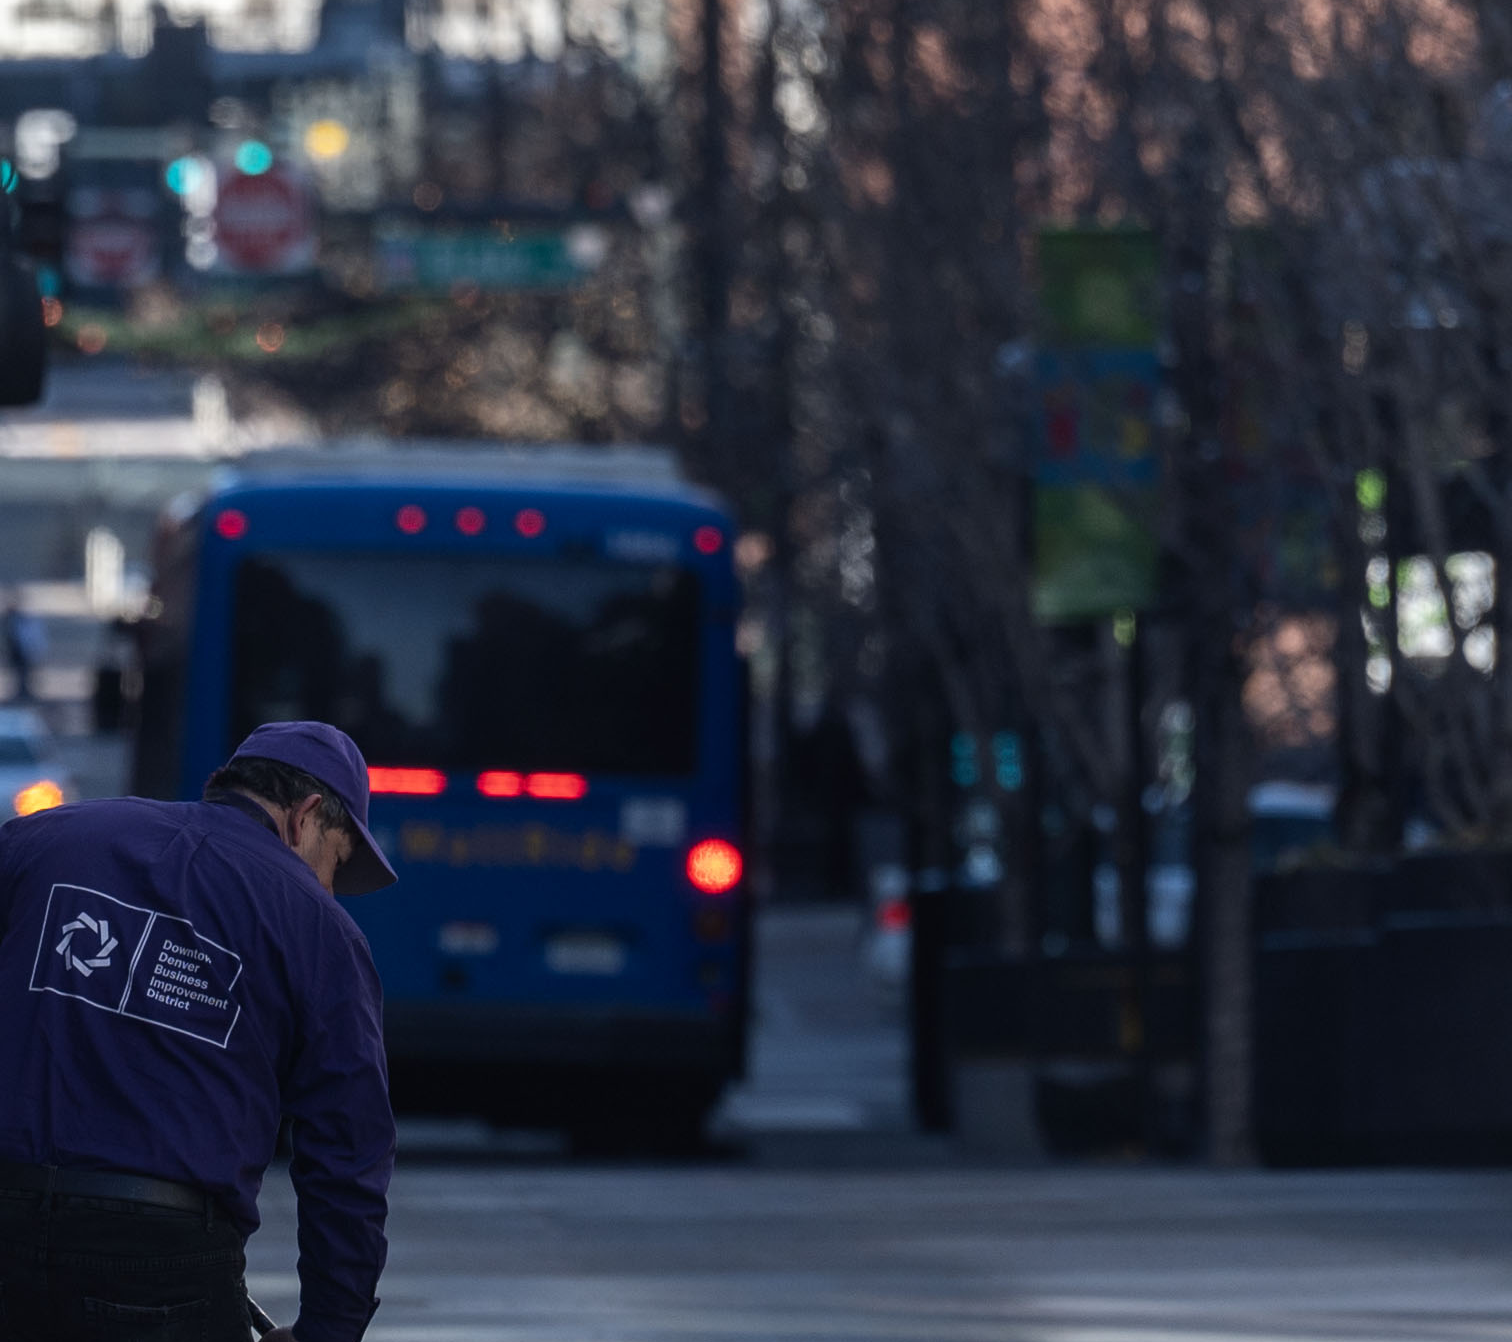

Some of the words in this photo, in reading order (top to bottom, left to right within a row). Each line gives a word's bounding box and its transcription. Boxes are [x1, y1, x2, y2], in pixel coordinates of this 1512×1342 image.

[158, 951, 201, 973] Denver
[153, 963, 209, 990] Business
[146, 987, 191, 1011] District
[149, 976, 229, 1010] Improvement
